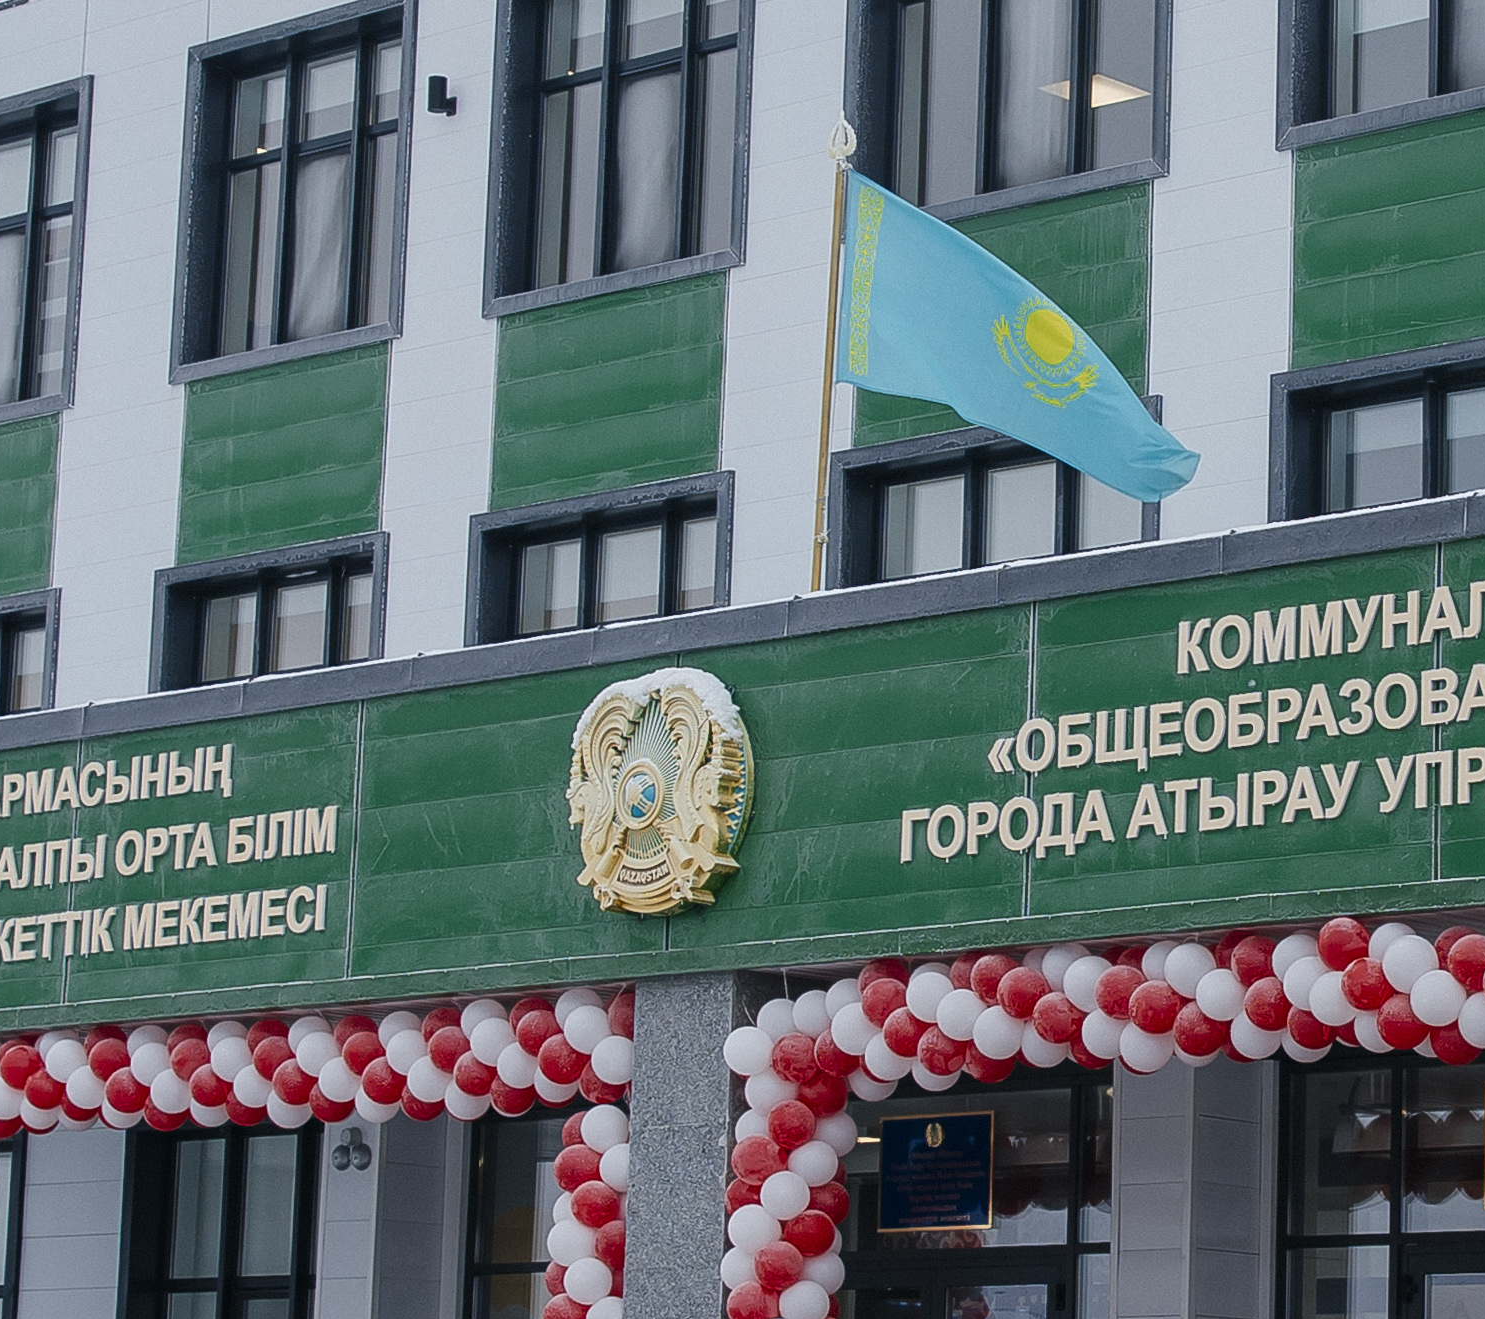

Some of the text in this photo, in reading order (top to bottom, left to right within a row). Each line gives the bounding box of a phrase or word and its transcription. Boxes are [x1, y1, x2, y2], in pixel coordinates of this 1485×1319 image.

[114, 822, 215, 876] ОРТА
[226, 805, 336, 864] БІЛІМ
[900, 790, 1114, 863] ГОРОДА
[1126, 761, 1358, 839] АТЫРАУ
[619, 863, 669, 884] QAZAQSTAN
[122, 884, 325, 950] МЕКЕМЕСІ
